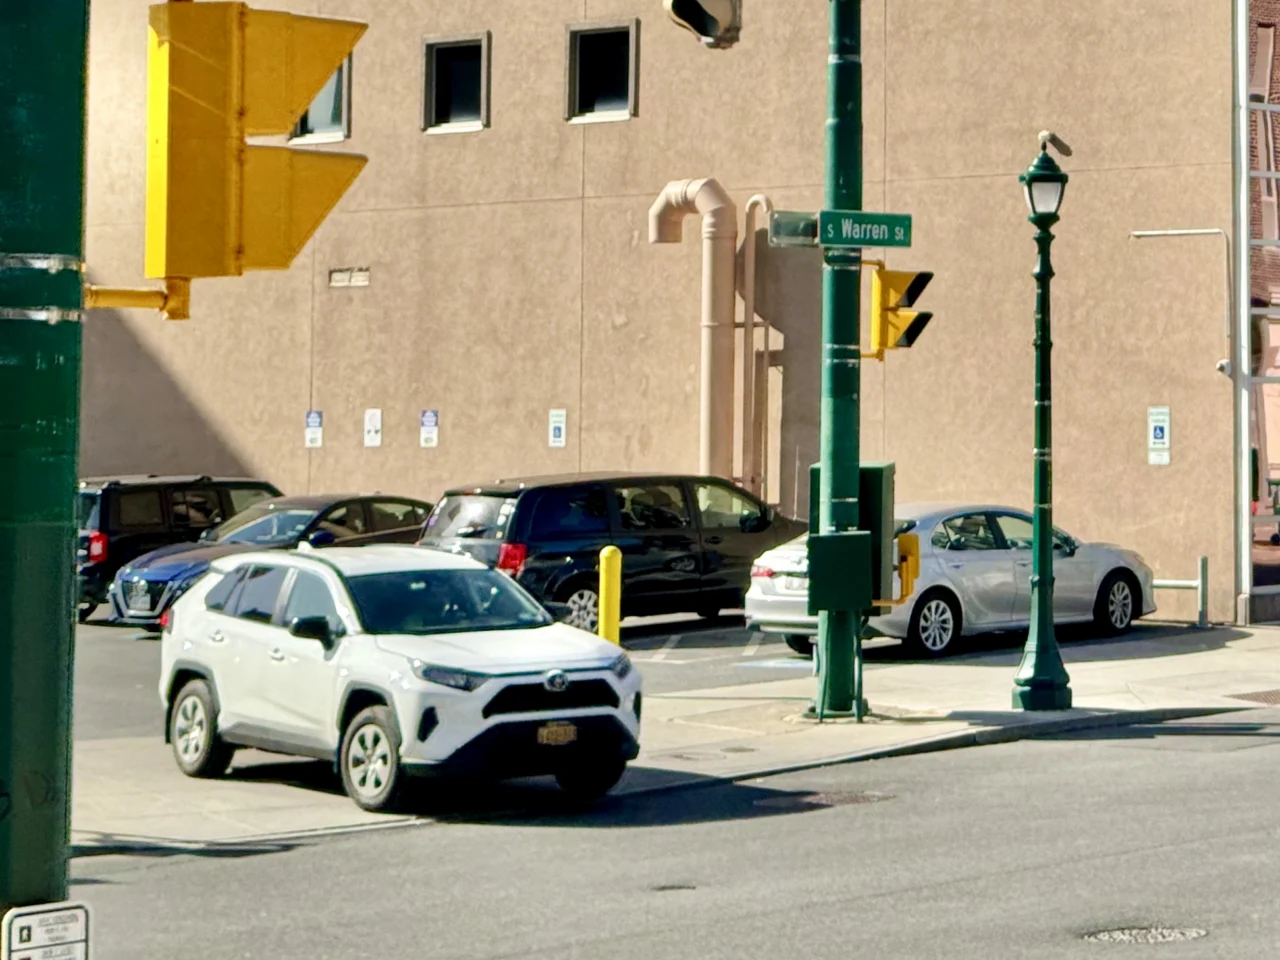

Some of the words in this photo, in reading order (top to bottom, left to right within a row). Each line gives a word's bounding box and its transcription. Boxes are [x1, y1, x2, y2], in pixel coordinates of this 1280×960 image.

[827, 223, 834, 238] S
[841, 218, 889, 239] Warren
[894, 227, 904, 240] St
